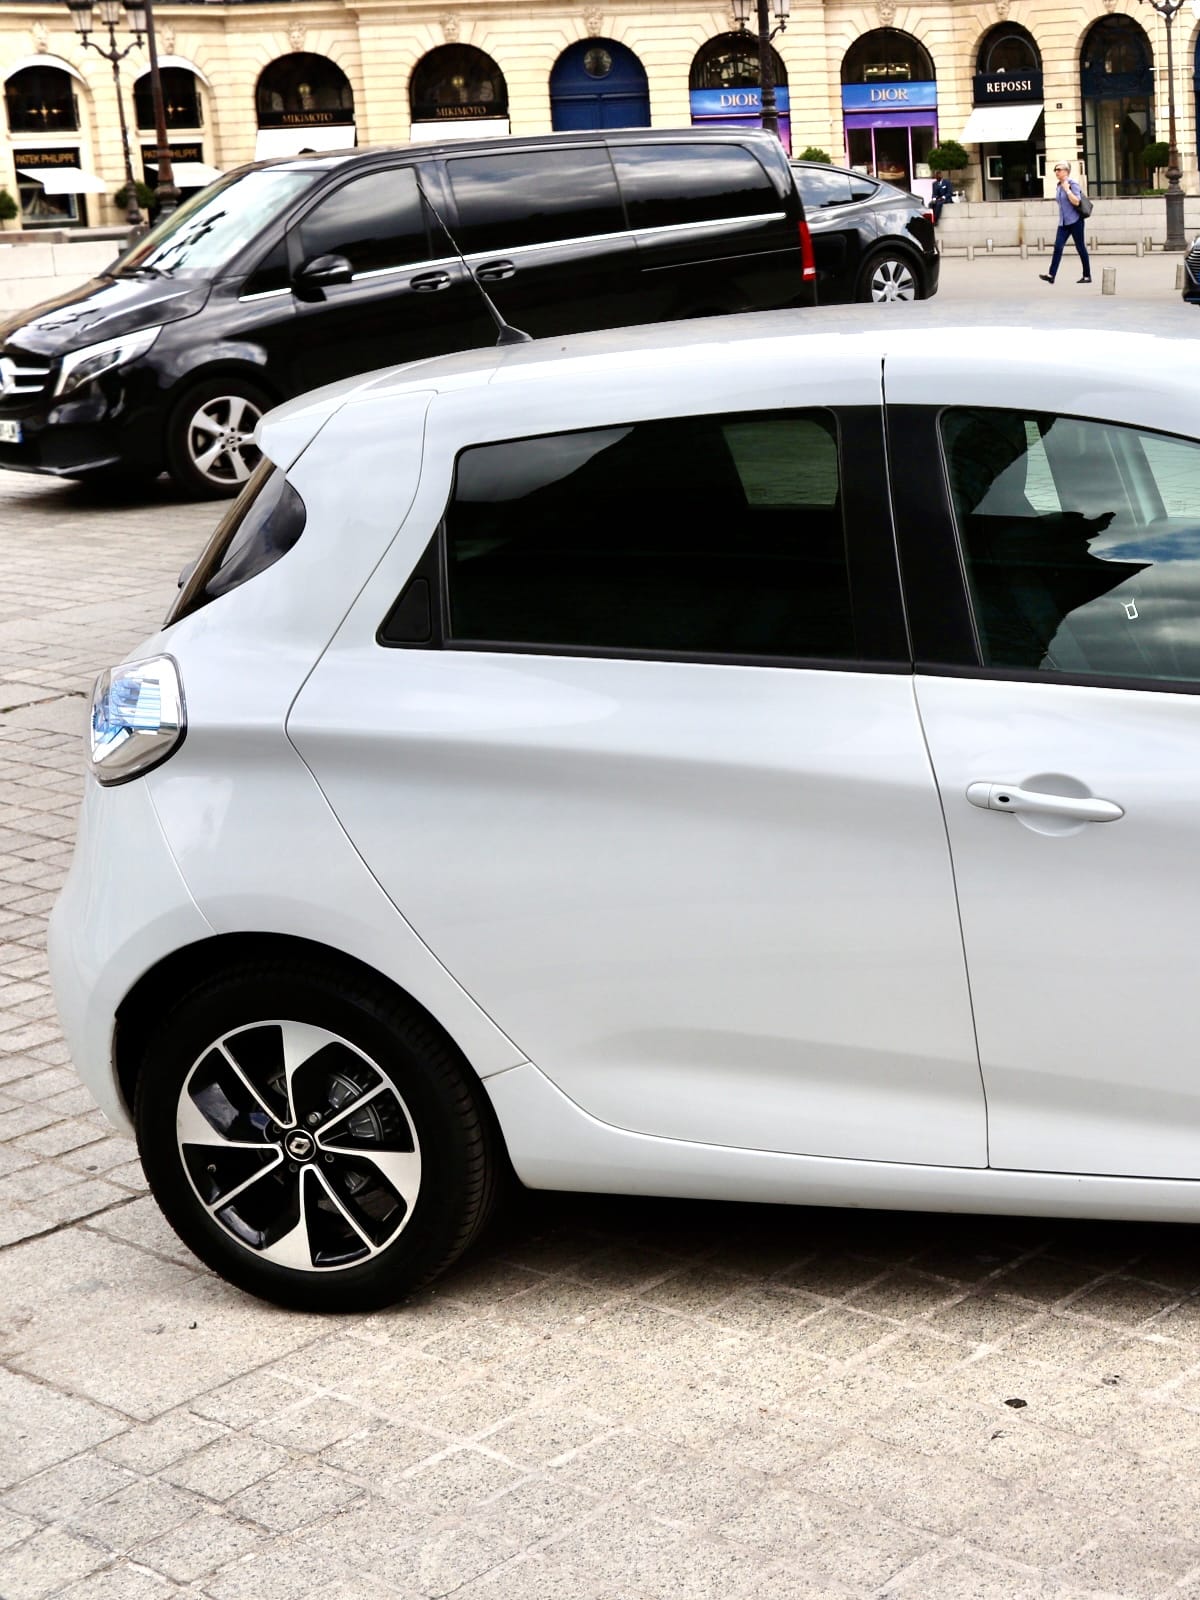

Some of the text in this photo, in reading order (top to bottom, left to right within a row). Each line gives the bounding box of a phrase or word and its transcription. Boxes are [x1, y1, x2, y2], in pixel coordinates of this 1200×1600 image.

[986, 80, 1032, 93] REPOSSI
[720, 93, 759, 107] DIOR
[869, 88, 909, 102] DIOR
[436, 105, 487, 117] MIKIMOTO
[282, 113, 333, 123] MIKIMOTO
[15, 152, 75, 165] PATEK PHILIPPE
